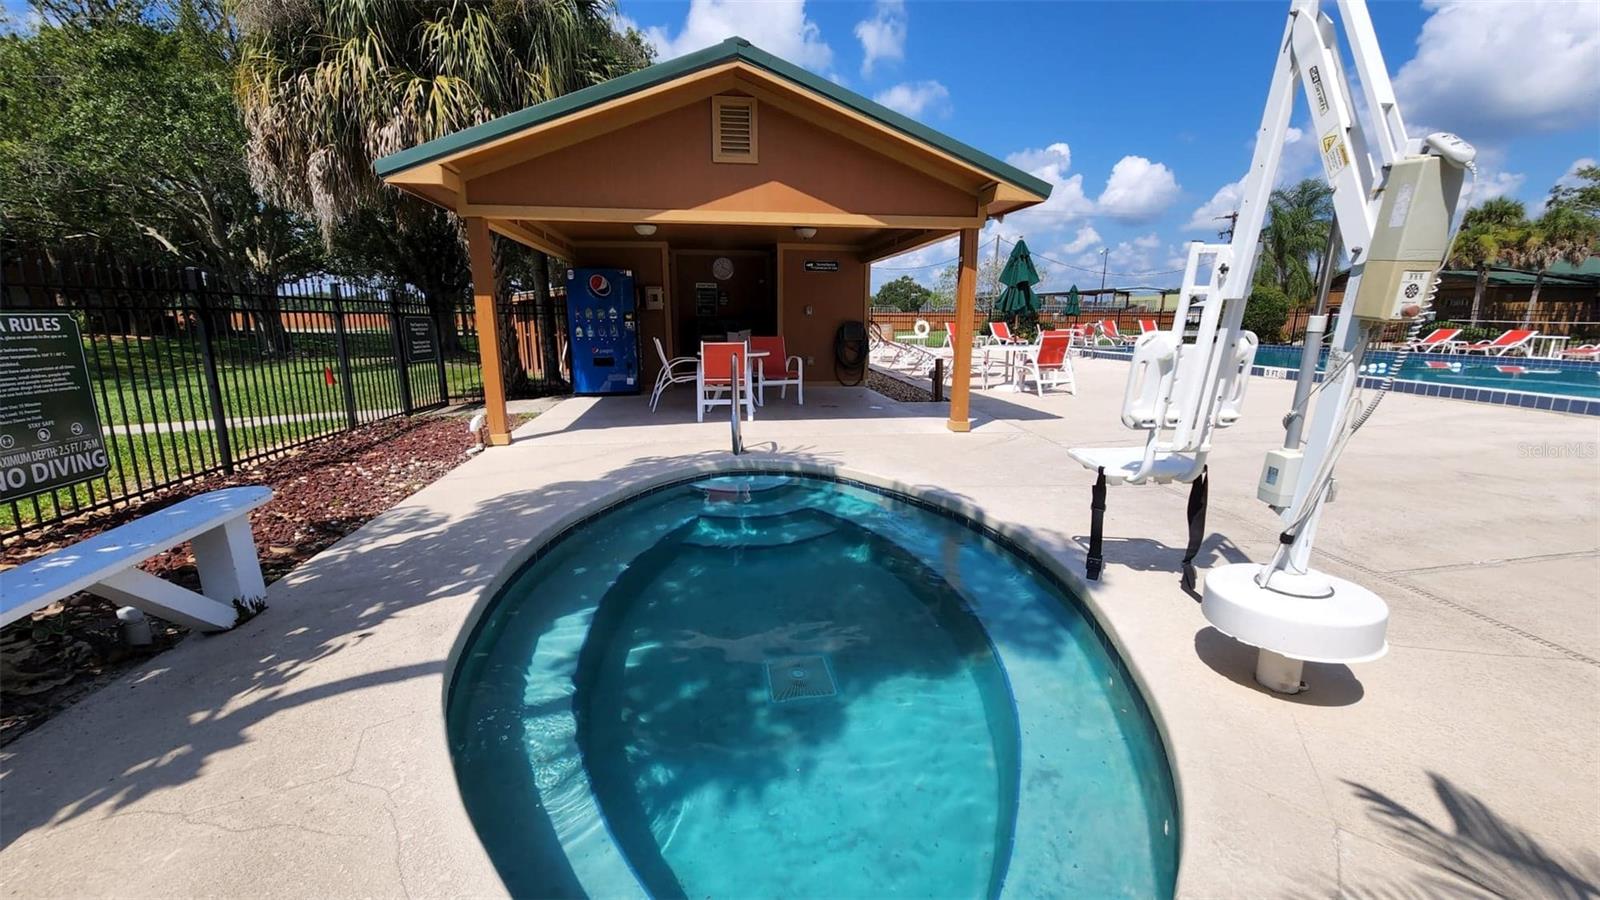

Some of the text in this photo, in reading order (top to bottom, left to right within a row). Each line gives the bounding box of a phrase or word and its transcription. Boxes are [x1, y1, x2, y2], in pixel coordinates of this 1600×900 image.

[8, 317, 61, 332] RULES
[31, 447, 59, 462] DEPTH:
[59, 445, 70, 456] 2.5
[71, 443, 79, 453] FT
[30, 449, 108, 484] DIVING
